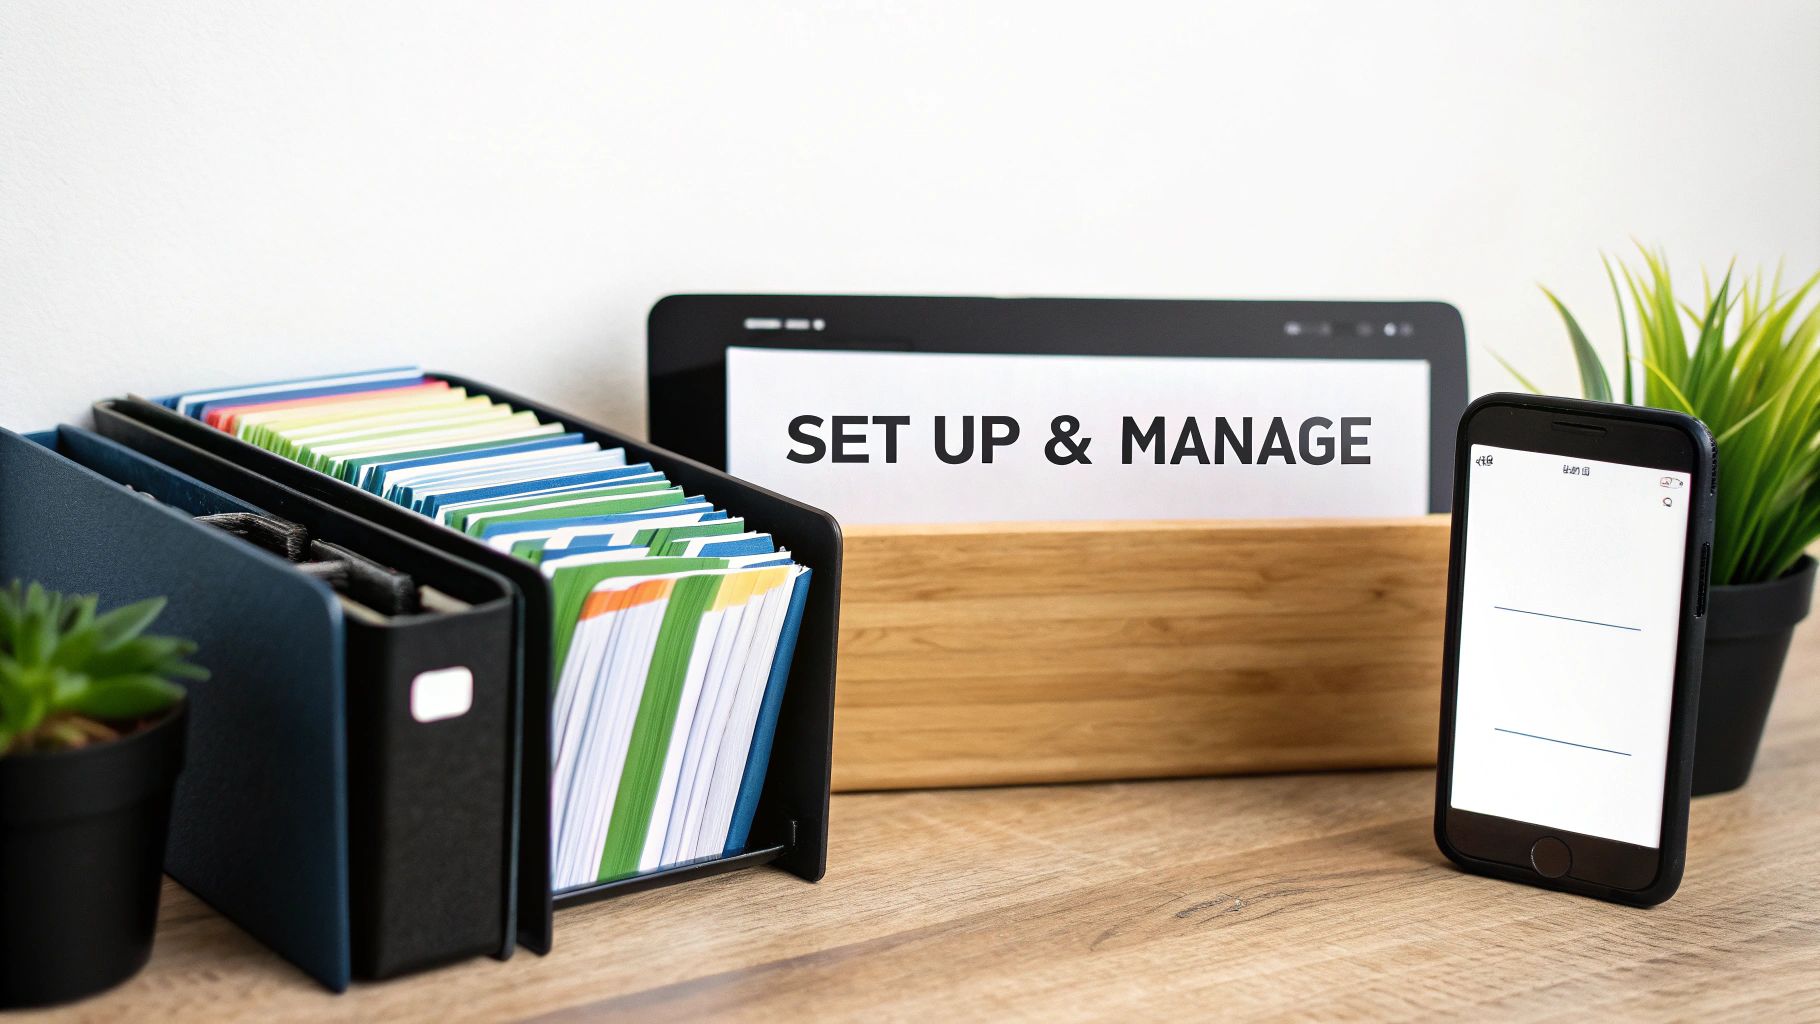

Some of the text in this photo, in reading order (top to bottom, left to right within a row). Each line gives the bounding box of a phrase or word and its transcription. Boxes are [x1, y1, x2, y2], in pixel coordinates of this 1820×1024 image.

[786, 414, 1372, 465] SET UP & MANAGE
